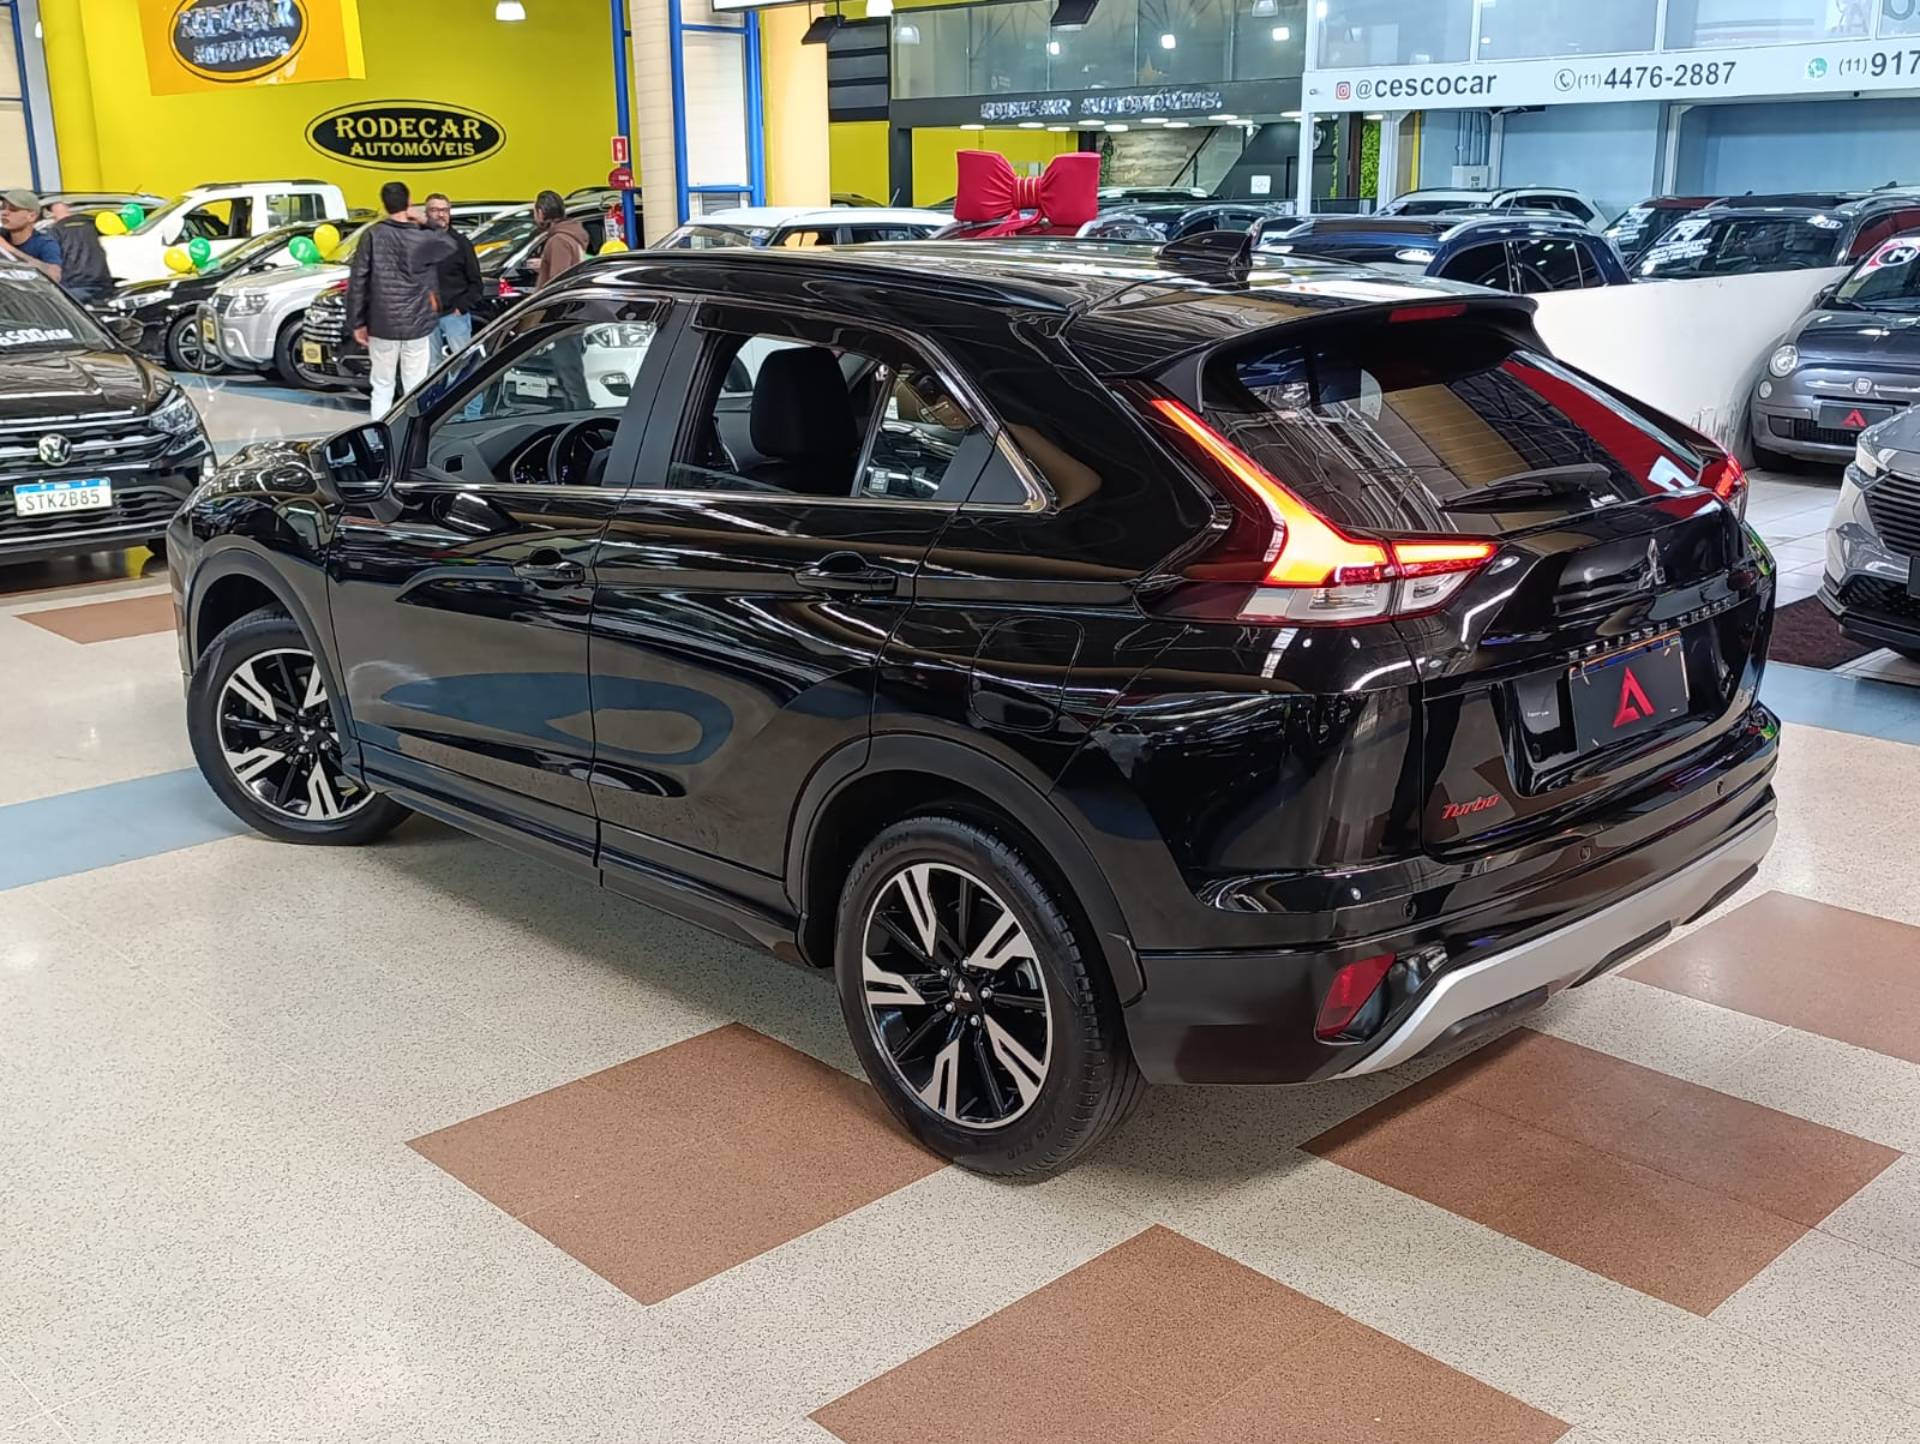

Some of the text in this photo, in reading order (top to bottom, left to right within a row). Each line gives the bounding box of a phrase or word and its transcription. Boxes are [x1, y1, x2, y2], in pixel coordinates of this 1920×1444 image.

[1356, 75, 1497, 99] @cescocar
[335, 117, 482, 139] RODECAR
[350, 139, 475, 156] AUTOMÓVEIS
[25, 488, 100, 511] STK2B85
